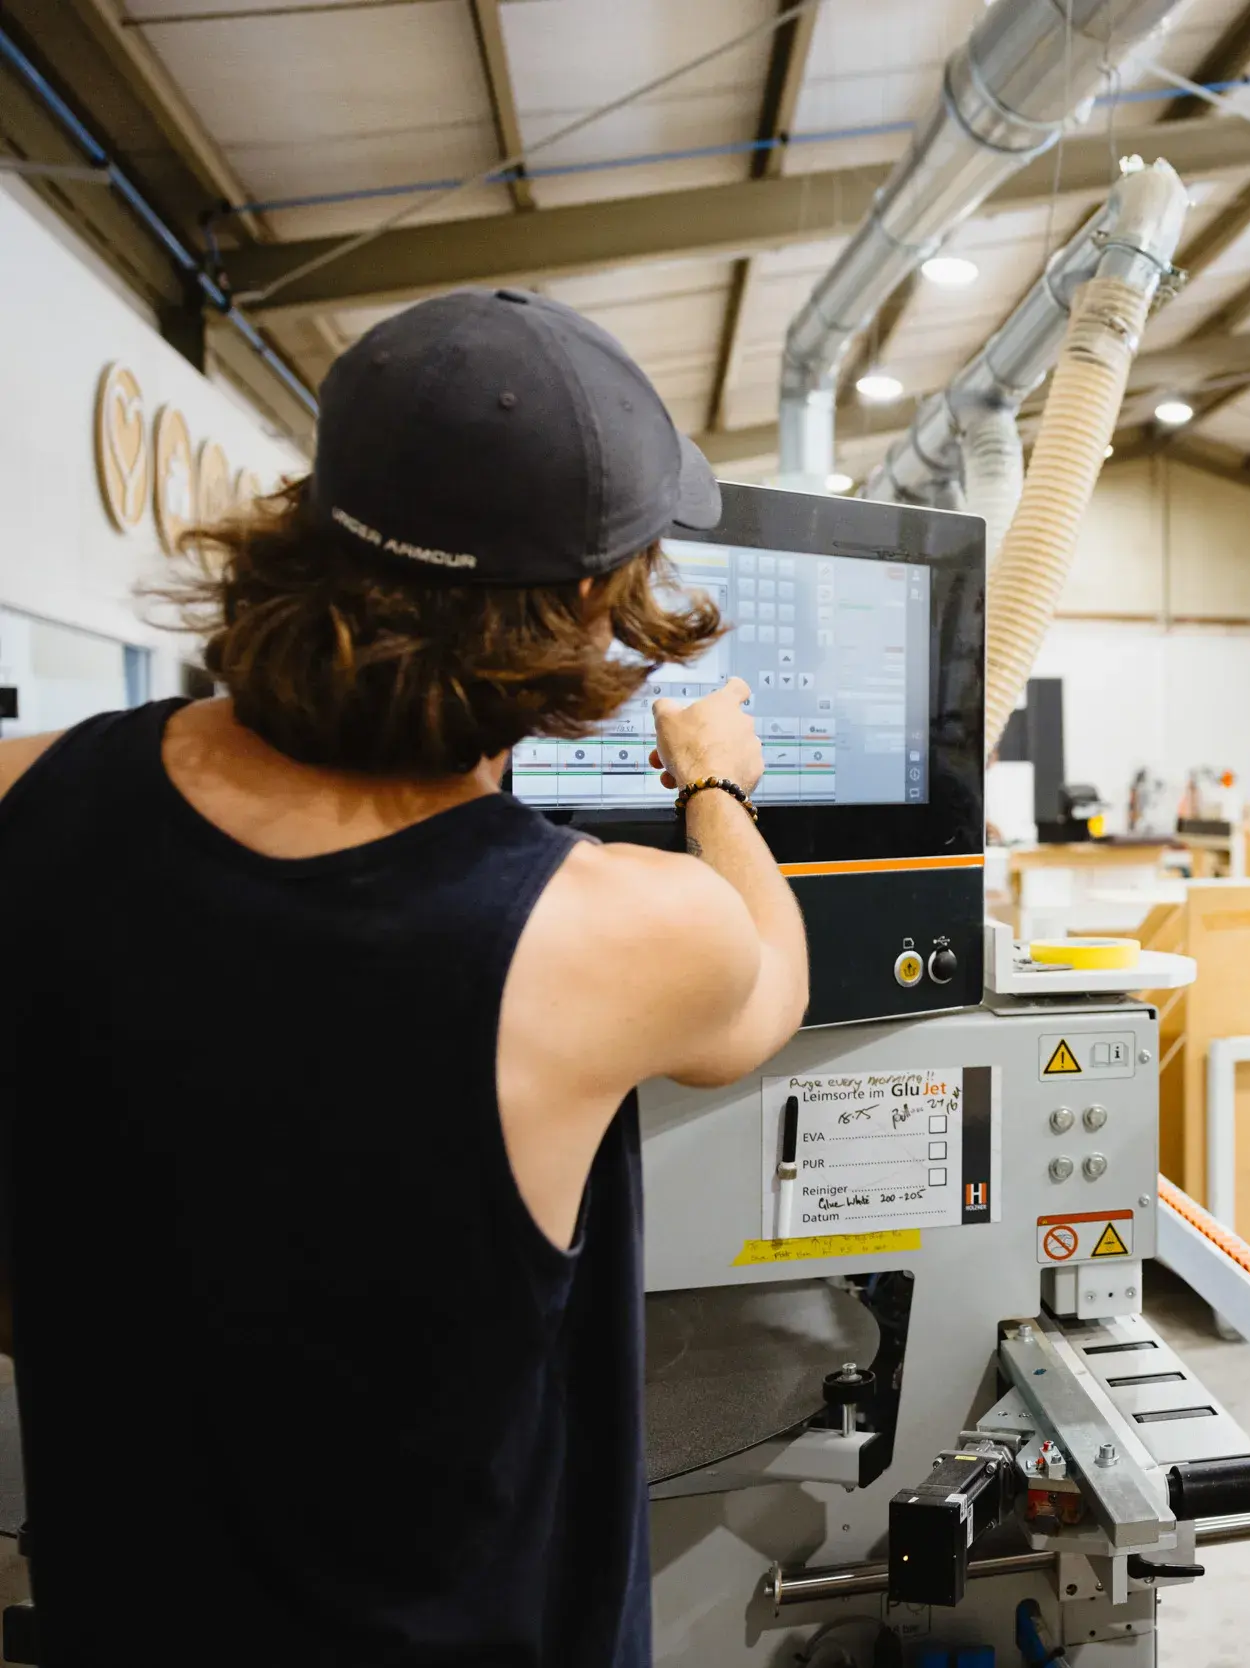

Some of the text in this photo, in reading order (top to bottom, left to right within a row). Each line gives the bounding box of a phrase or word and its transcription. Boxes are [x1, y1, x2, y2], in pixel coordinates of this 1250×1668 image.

[332, 506, 477, 569] UNDER ARMOUR
[828, 1078, 863, 1091] every
[803, 1089, 866, 1102] Leimsorte
[869, 1087, 885, 1099] im
[803, 1132, 826, 1143] EVA
[802, 1158, 825, 1169] PUR
[802, 1185, 848, 1197] Reiniger
[818, 1198, 844, 1210] Glue
[802, 1213, 840, 1223] Datum
